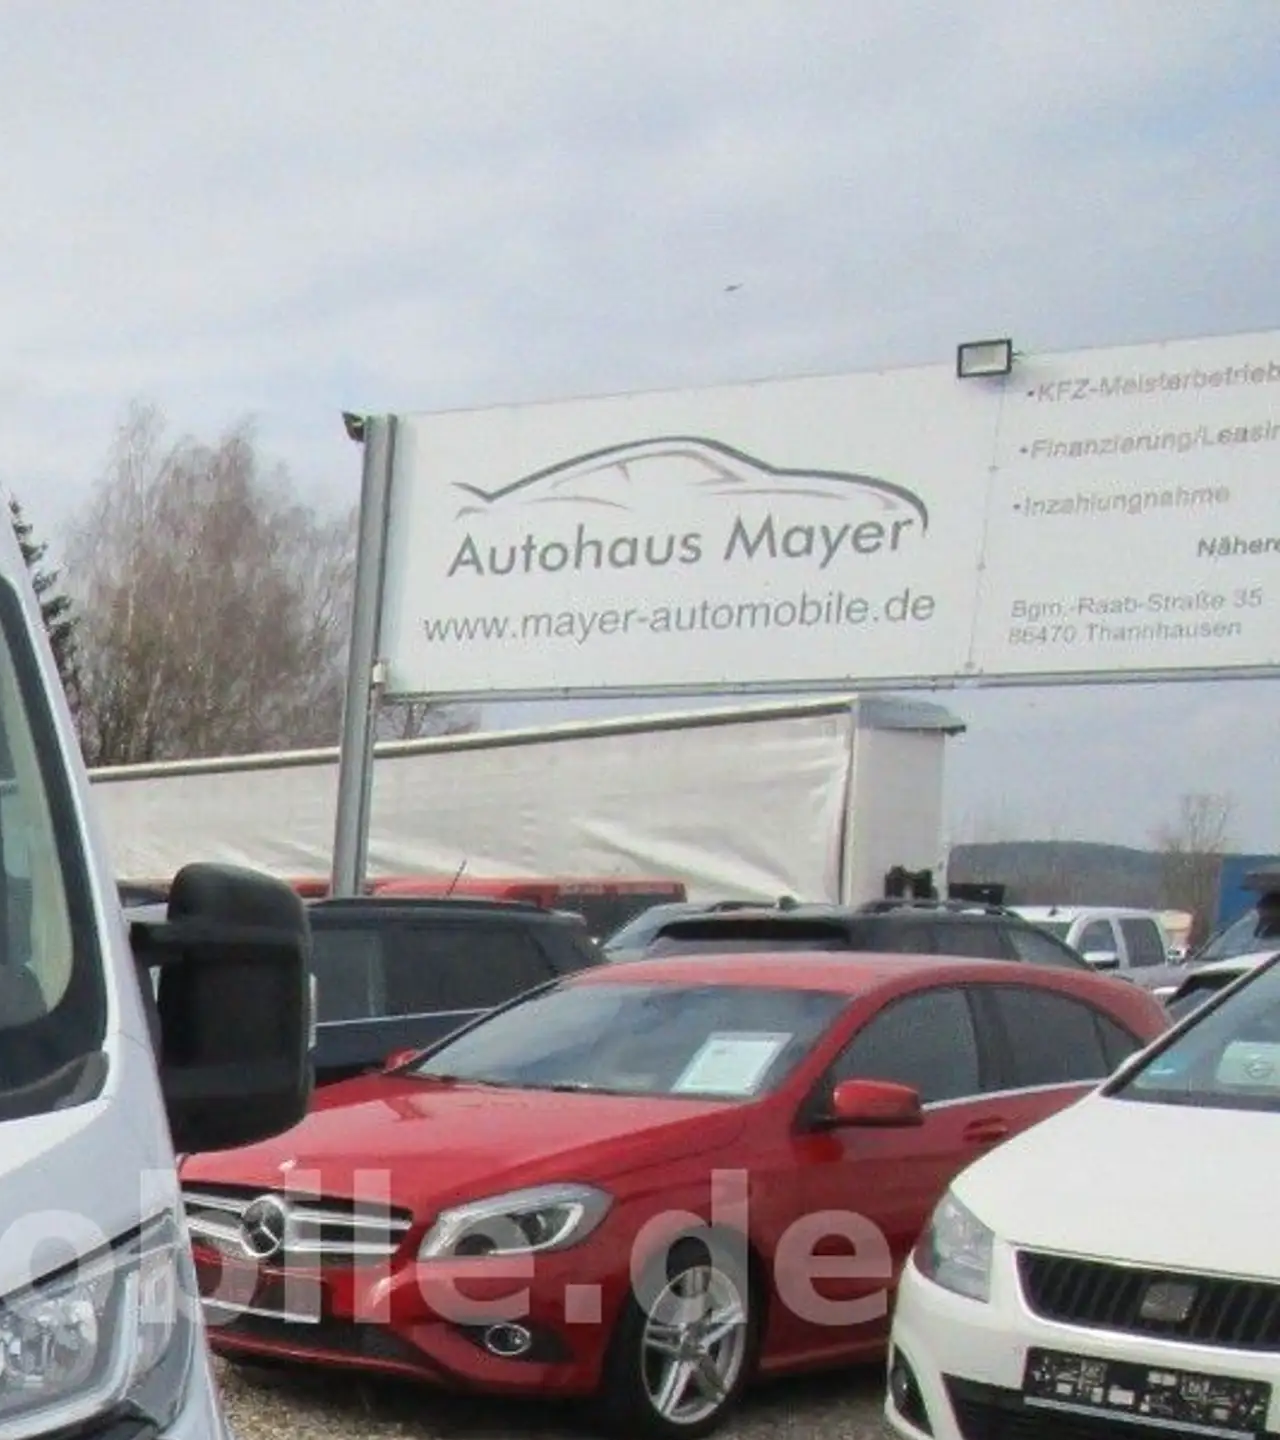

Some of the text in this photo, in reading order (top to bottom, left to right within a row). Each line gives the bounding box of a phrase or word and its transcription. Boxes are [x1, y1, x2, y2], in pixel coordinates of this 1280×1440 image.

[446, 513, 915, 577] Autohaus Mayer
[423, 587, 937, 645] www.mayer-automobile.de
